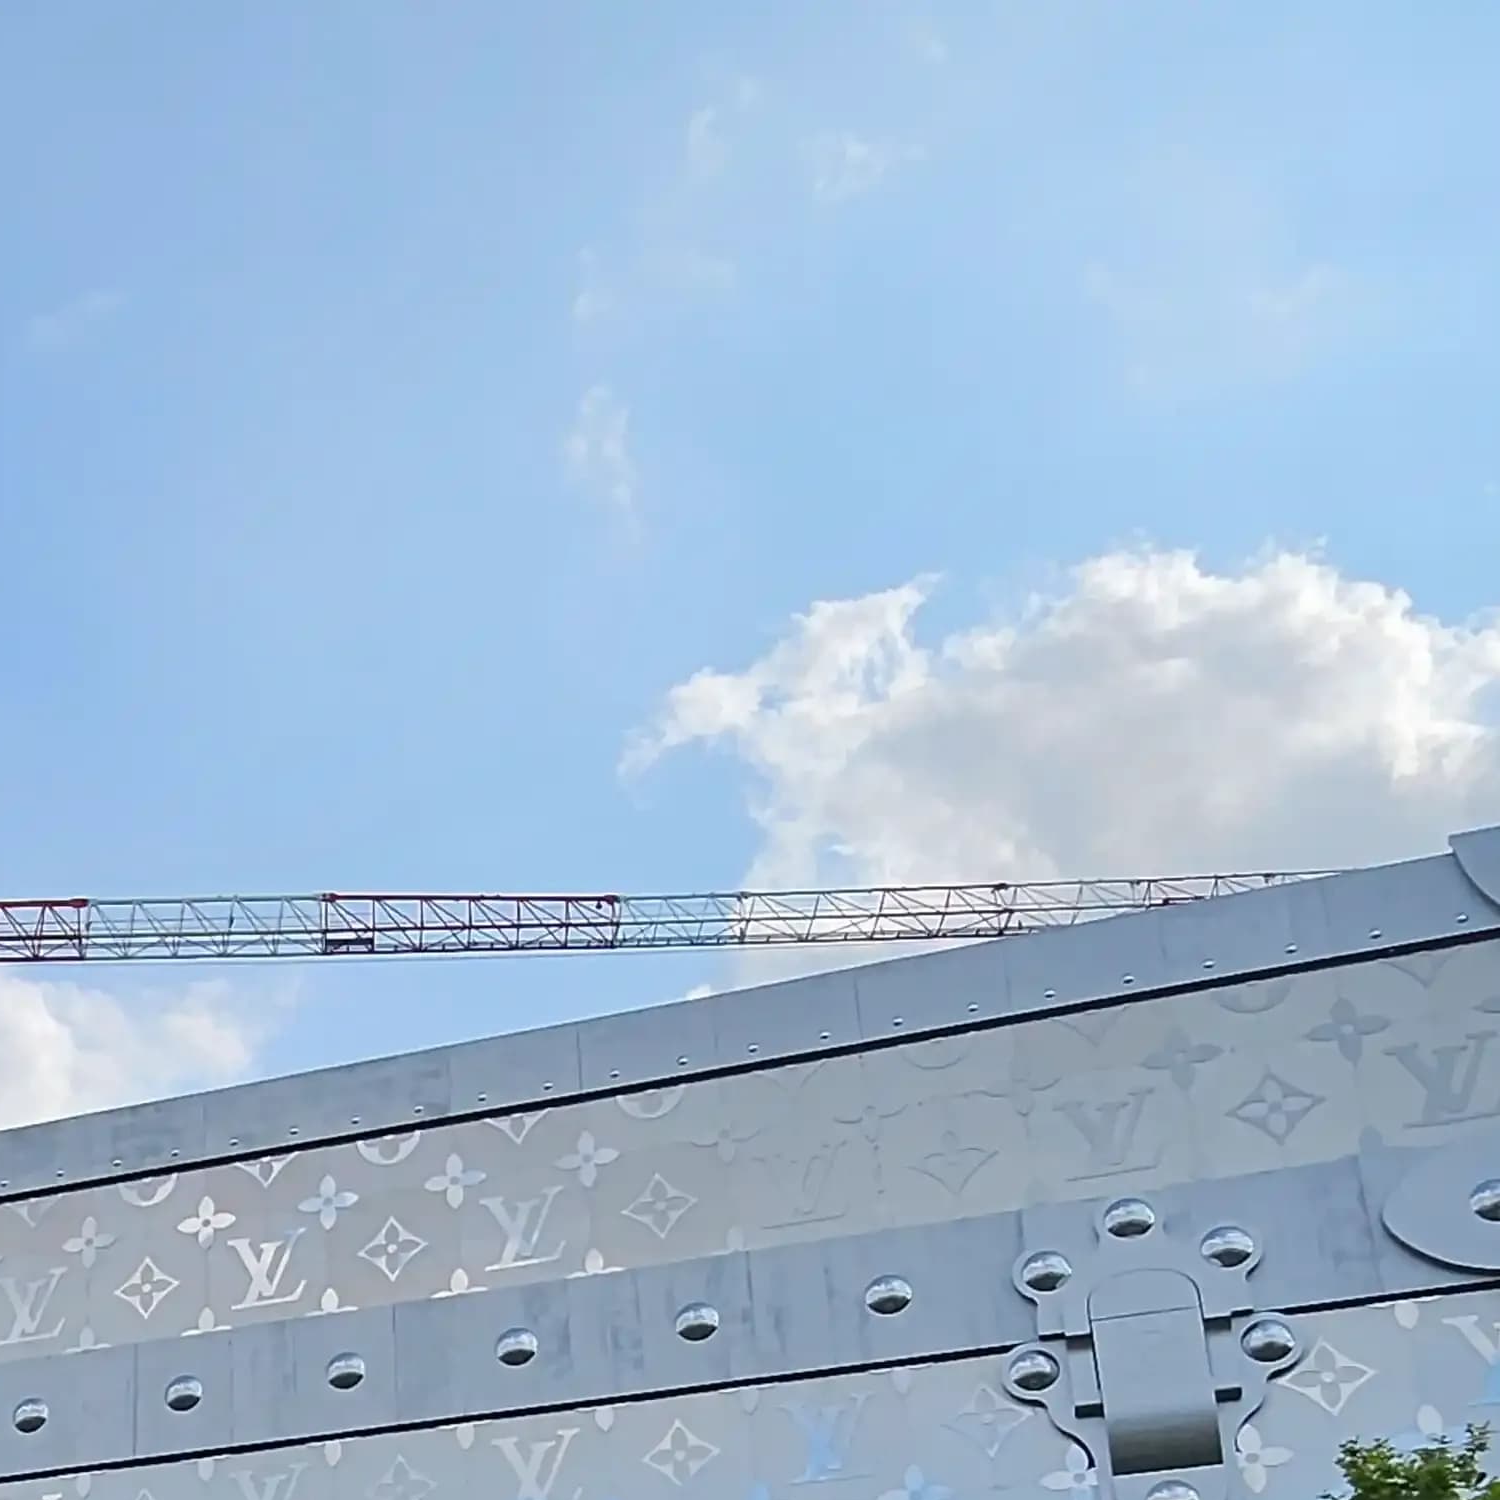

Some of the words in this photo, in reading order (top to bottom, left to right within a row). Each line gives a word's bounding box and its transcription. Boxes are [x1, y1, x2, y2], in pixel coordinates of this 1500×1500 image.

[1382, 1030, 1499, 1128] LV
[1053, 1087, 1161, 1181] LV
[227, 1228, 308, 1311] LV
[480, 1185, 567, 1272] LV
